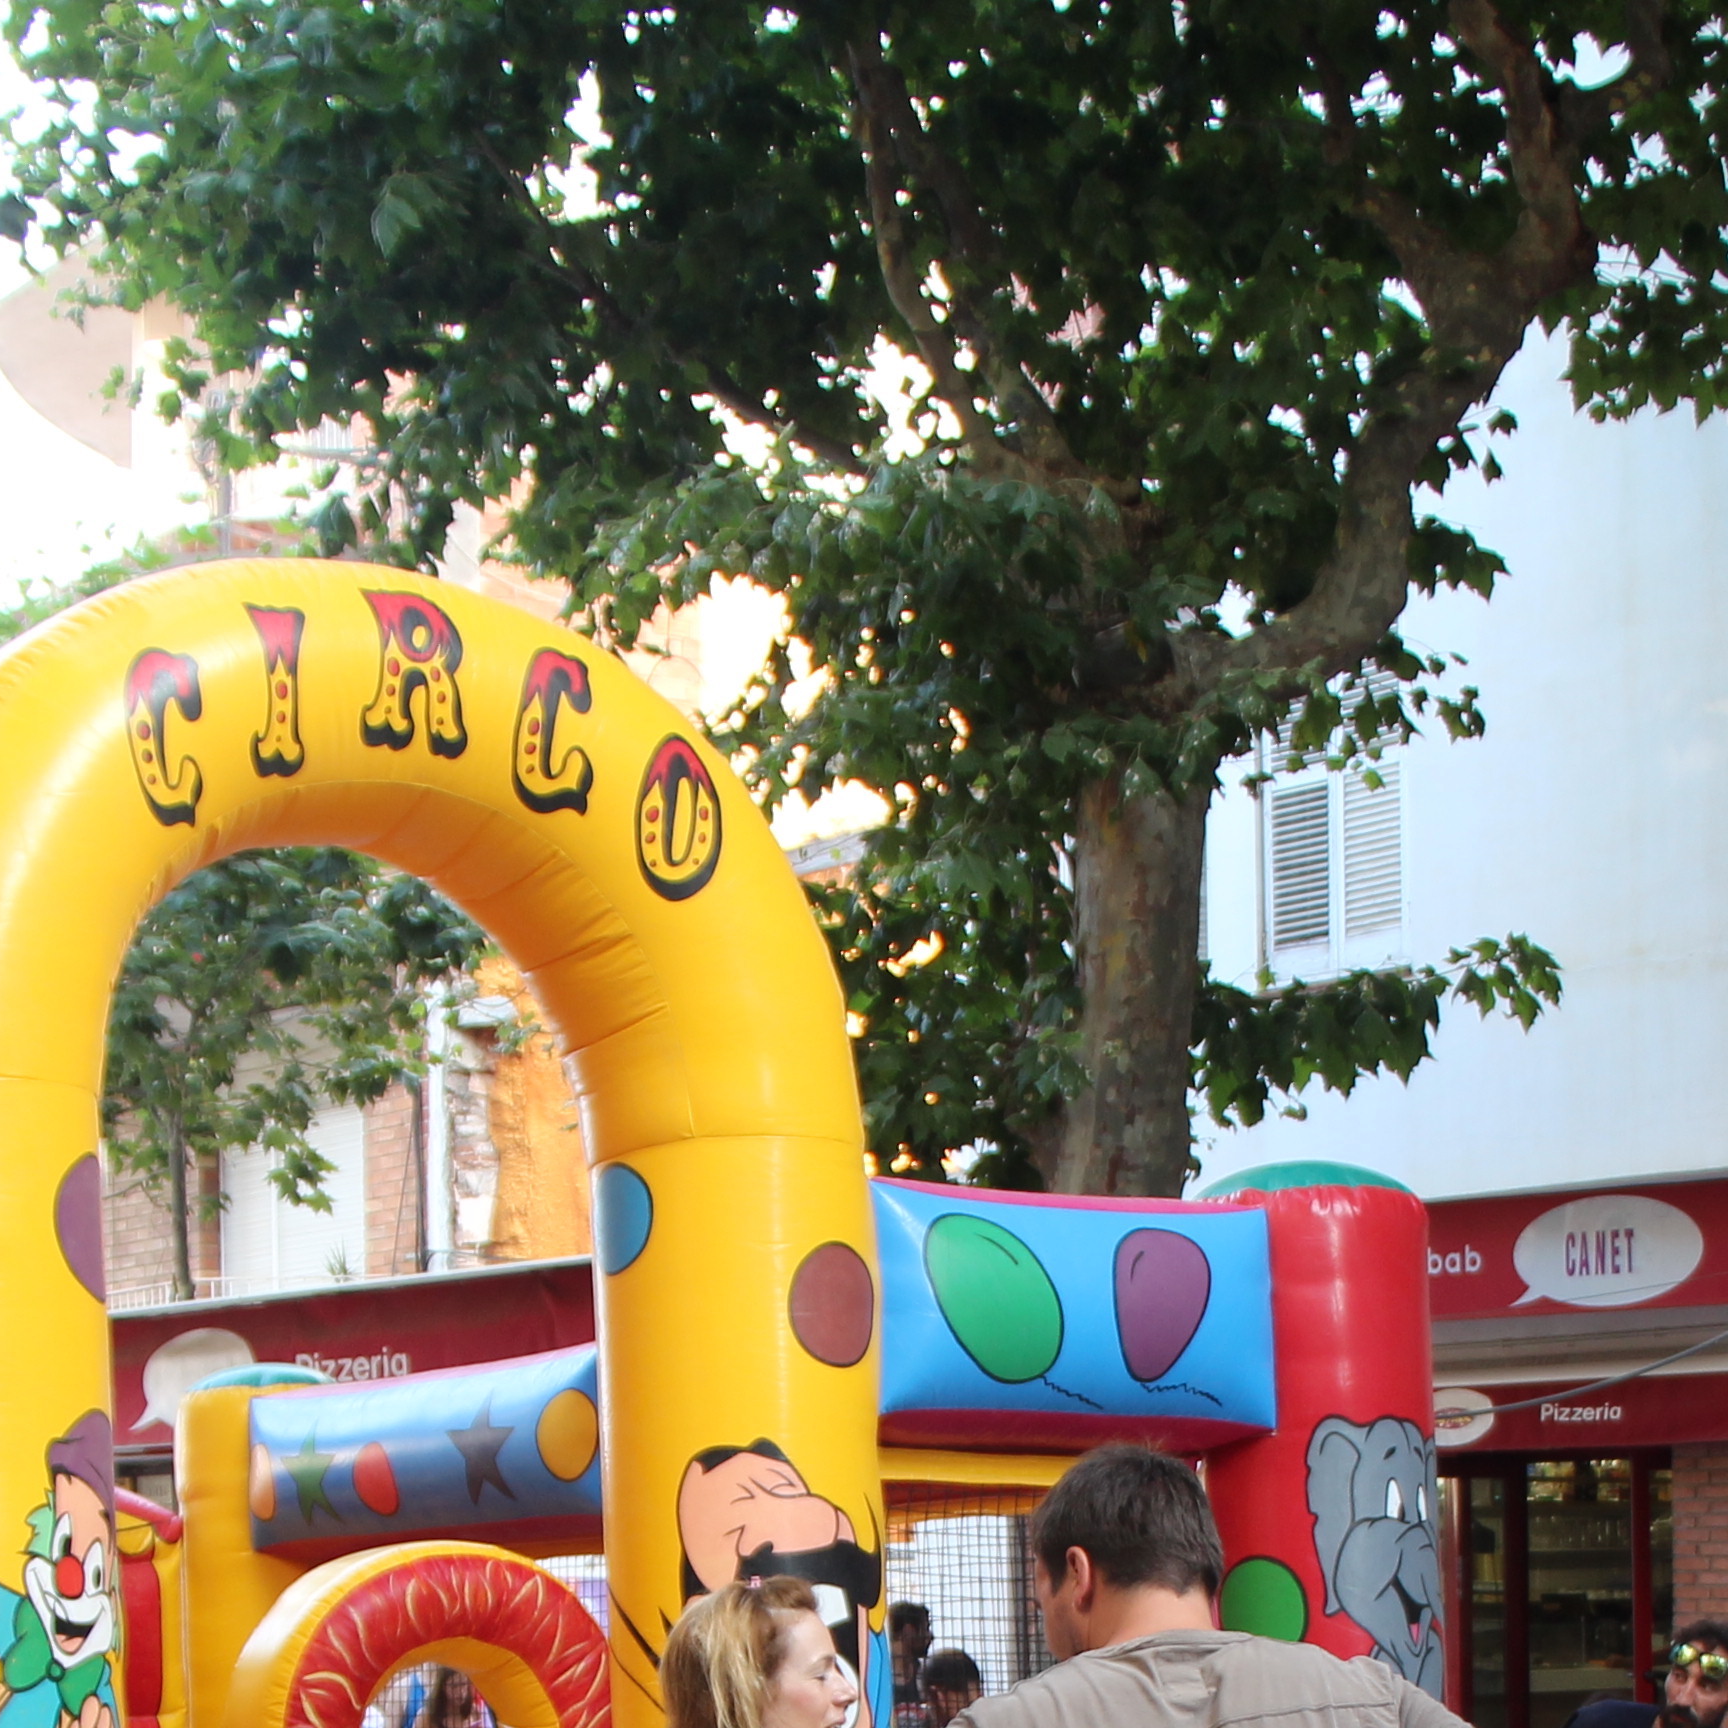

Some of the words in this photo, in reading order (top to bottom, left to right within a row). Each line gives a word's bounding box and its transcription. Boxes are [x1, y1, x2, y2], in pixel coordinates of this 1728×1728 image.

[124, 588, 723, 901] CIRCO
[1427, 1244, 1482, 1275] bab
[1565, 1228, 1635, 1278] CANET
[1540, 1402, 1622, 1422] Pizzeria
